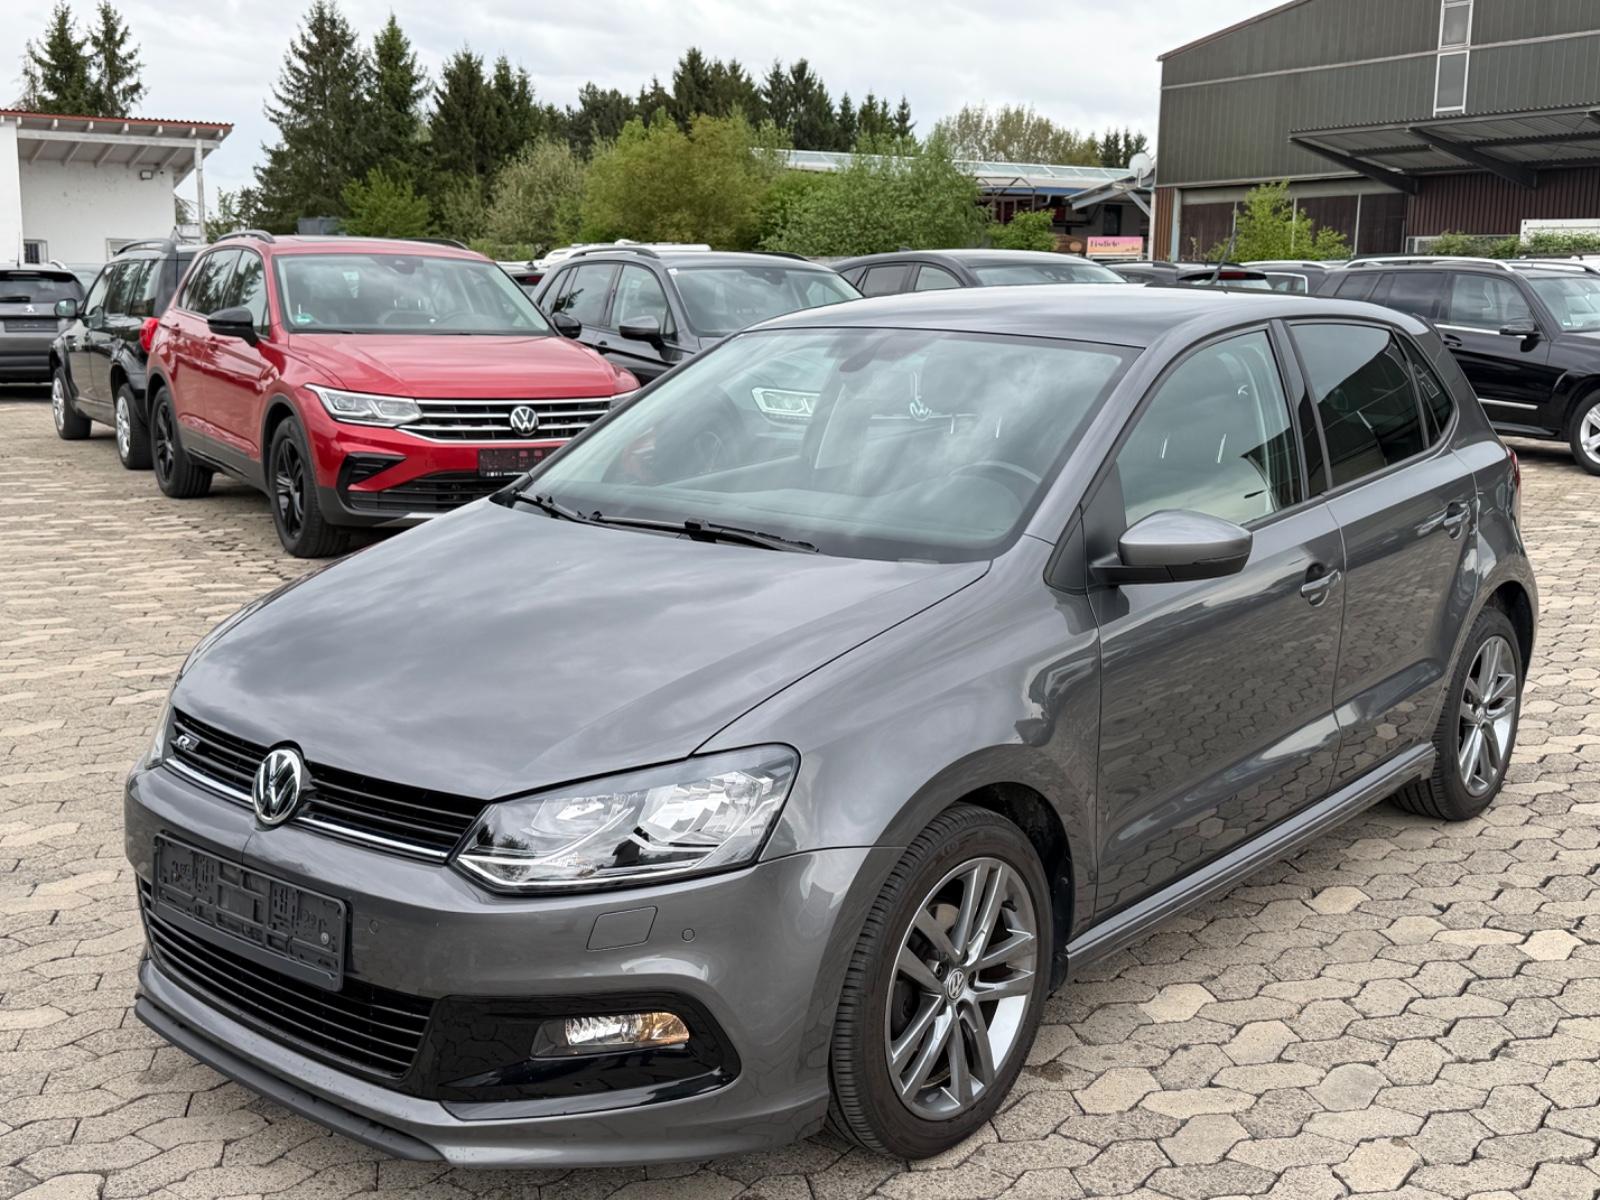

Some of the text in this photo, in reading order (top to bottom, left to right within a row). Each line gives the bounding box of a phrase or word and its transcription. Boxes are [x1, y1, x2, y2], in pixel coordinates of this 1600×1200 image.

[510, 407, 538, 435] VW
[176, 735, 192, 751] R
[253, 750, 301, 815] VW
[948, 970, 964, 999] VW
